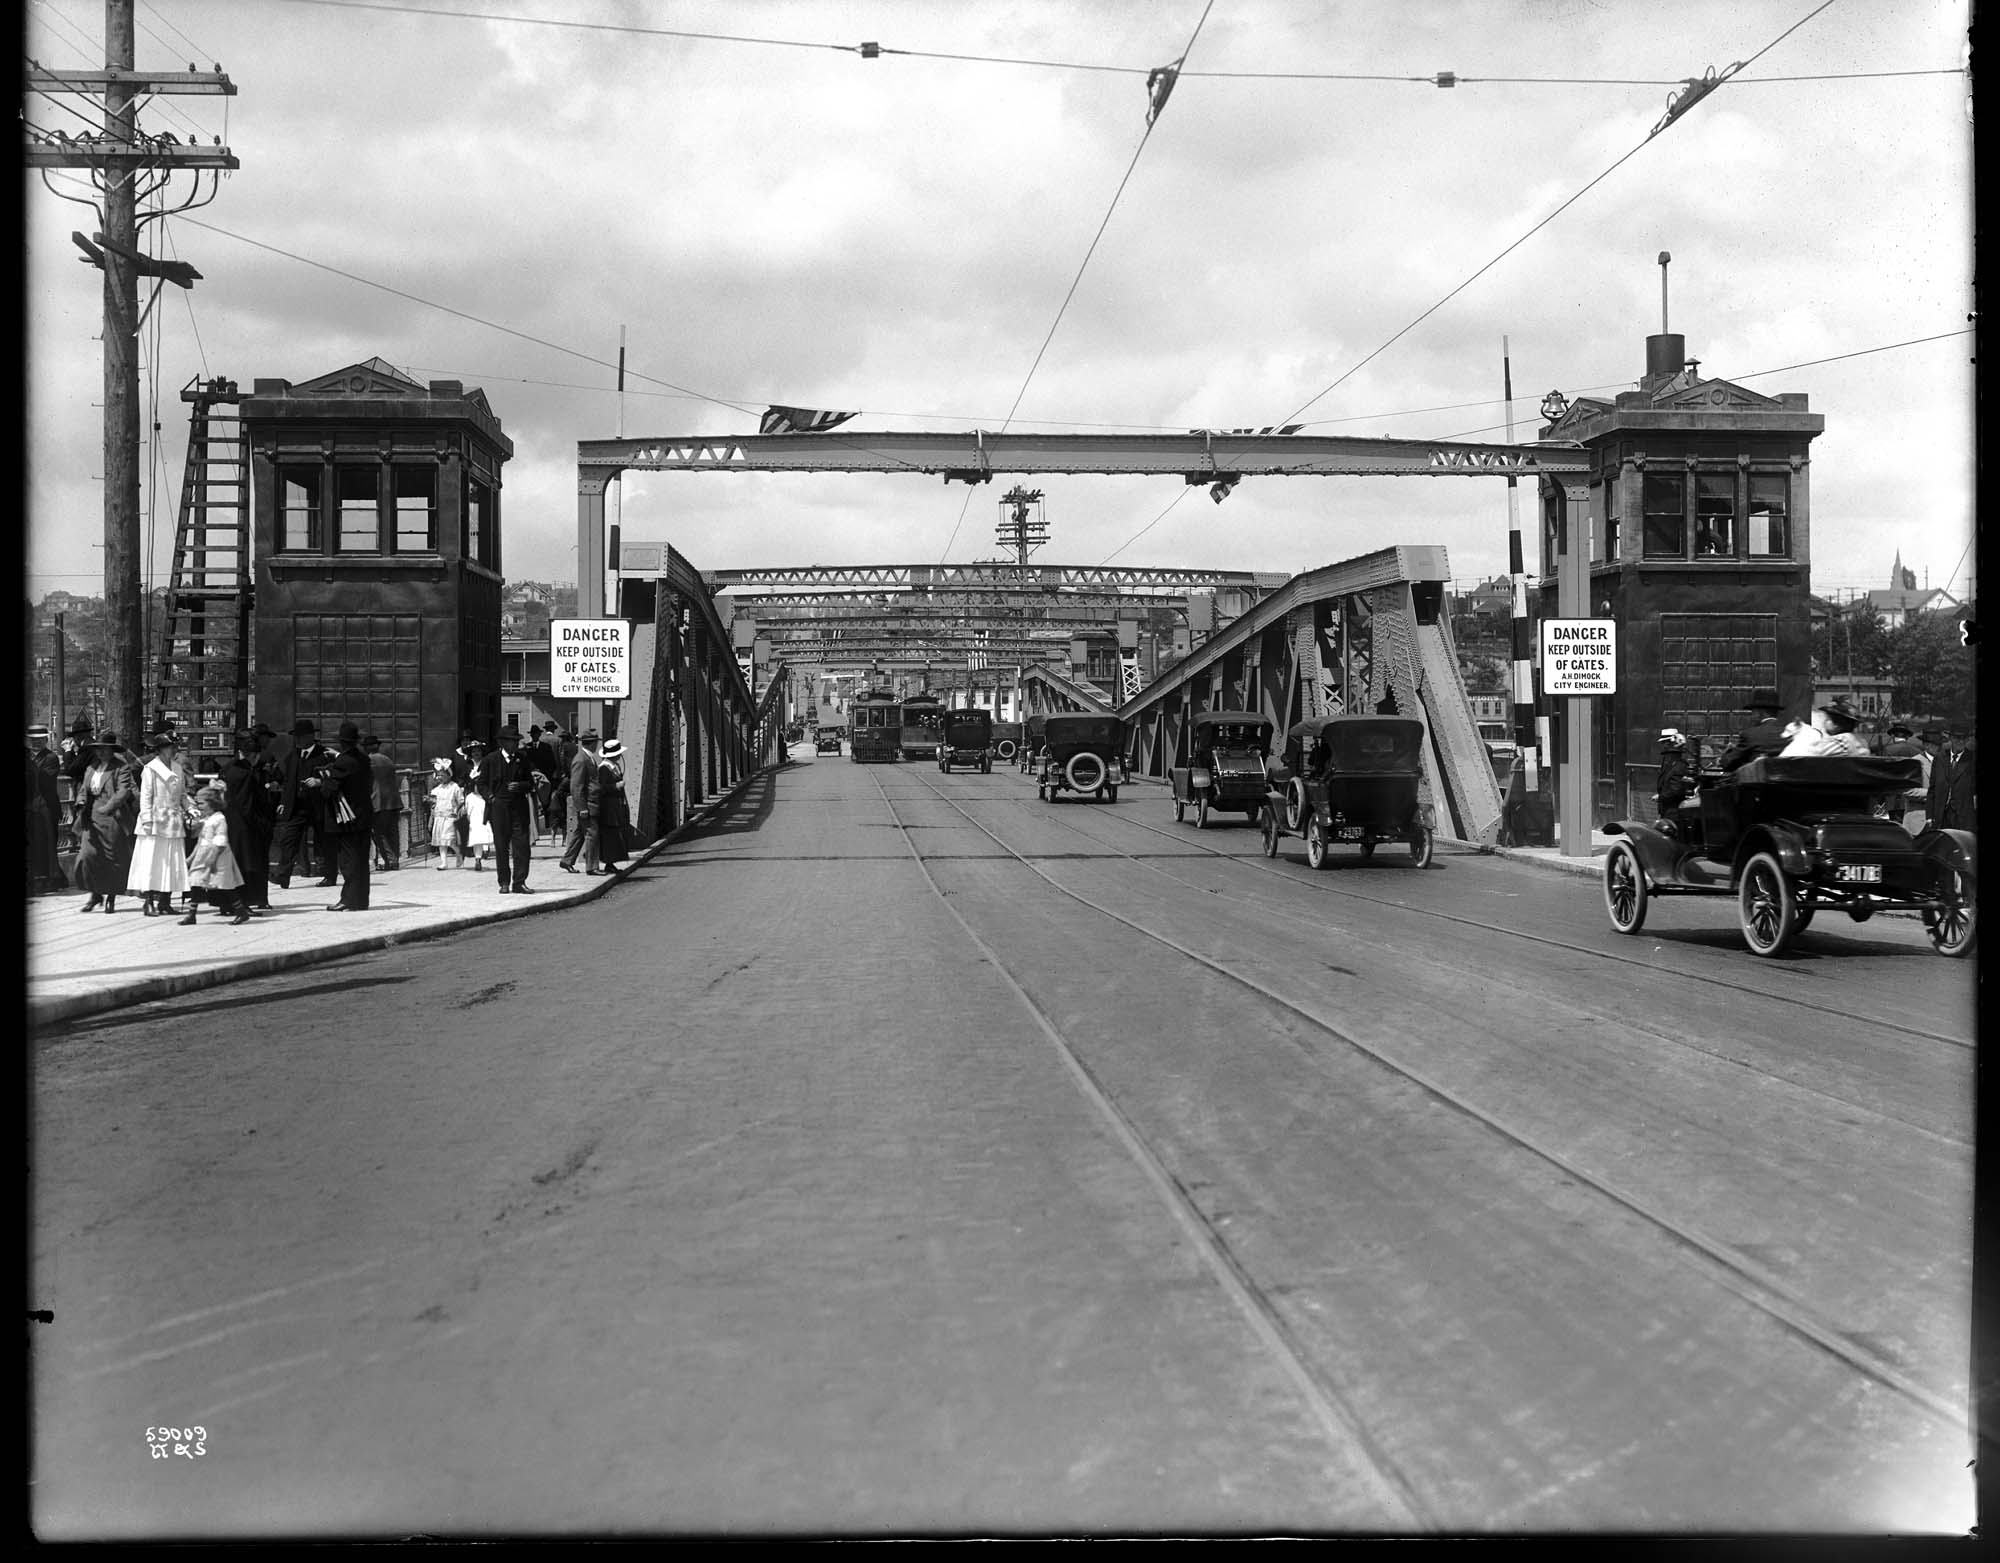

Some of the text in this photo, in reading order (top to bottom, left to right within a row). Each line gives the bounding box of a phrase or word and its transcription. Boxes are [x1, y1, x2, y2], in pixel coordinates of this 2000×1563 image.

[562, 628, 621, 641] DANGER
[1553, 627, 1608, 640] DANGER
[556, 646, 624, 657] KEEP OUTSIDE
[1548, 644, 1612, 655] KEEP OUTSIDE
[564, 662, 578, 673] OF
[1556, 660, 1608, 671] OF GATES.
